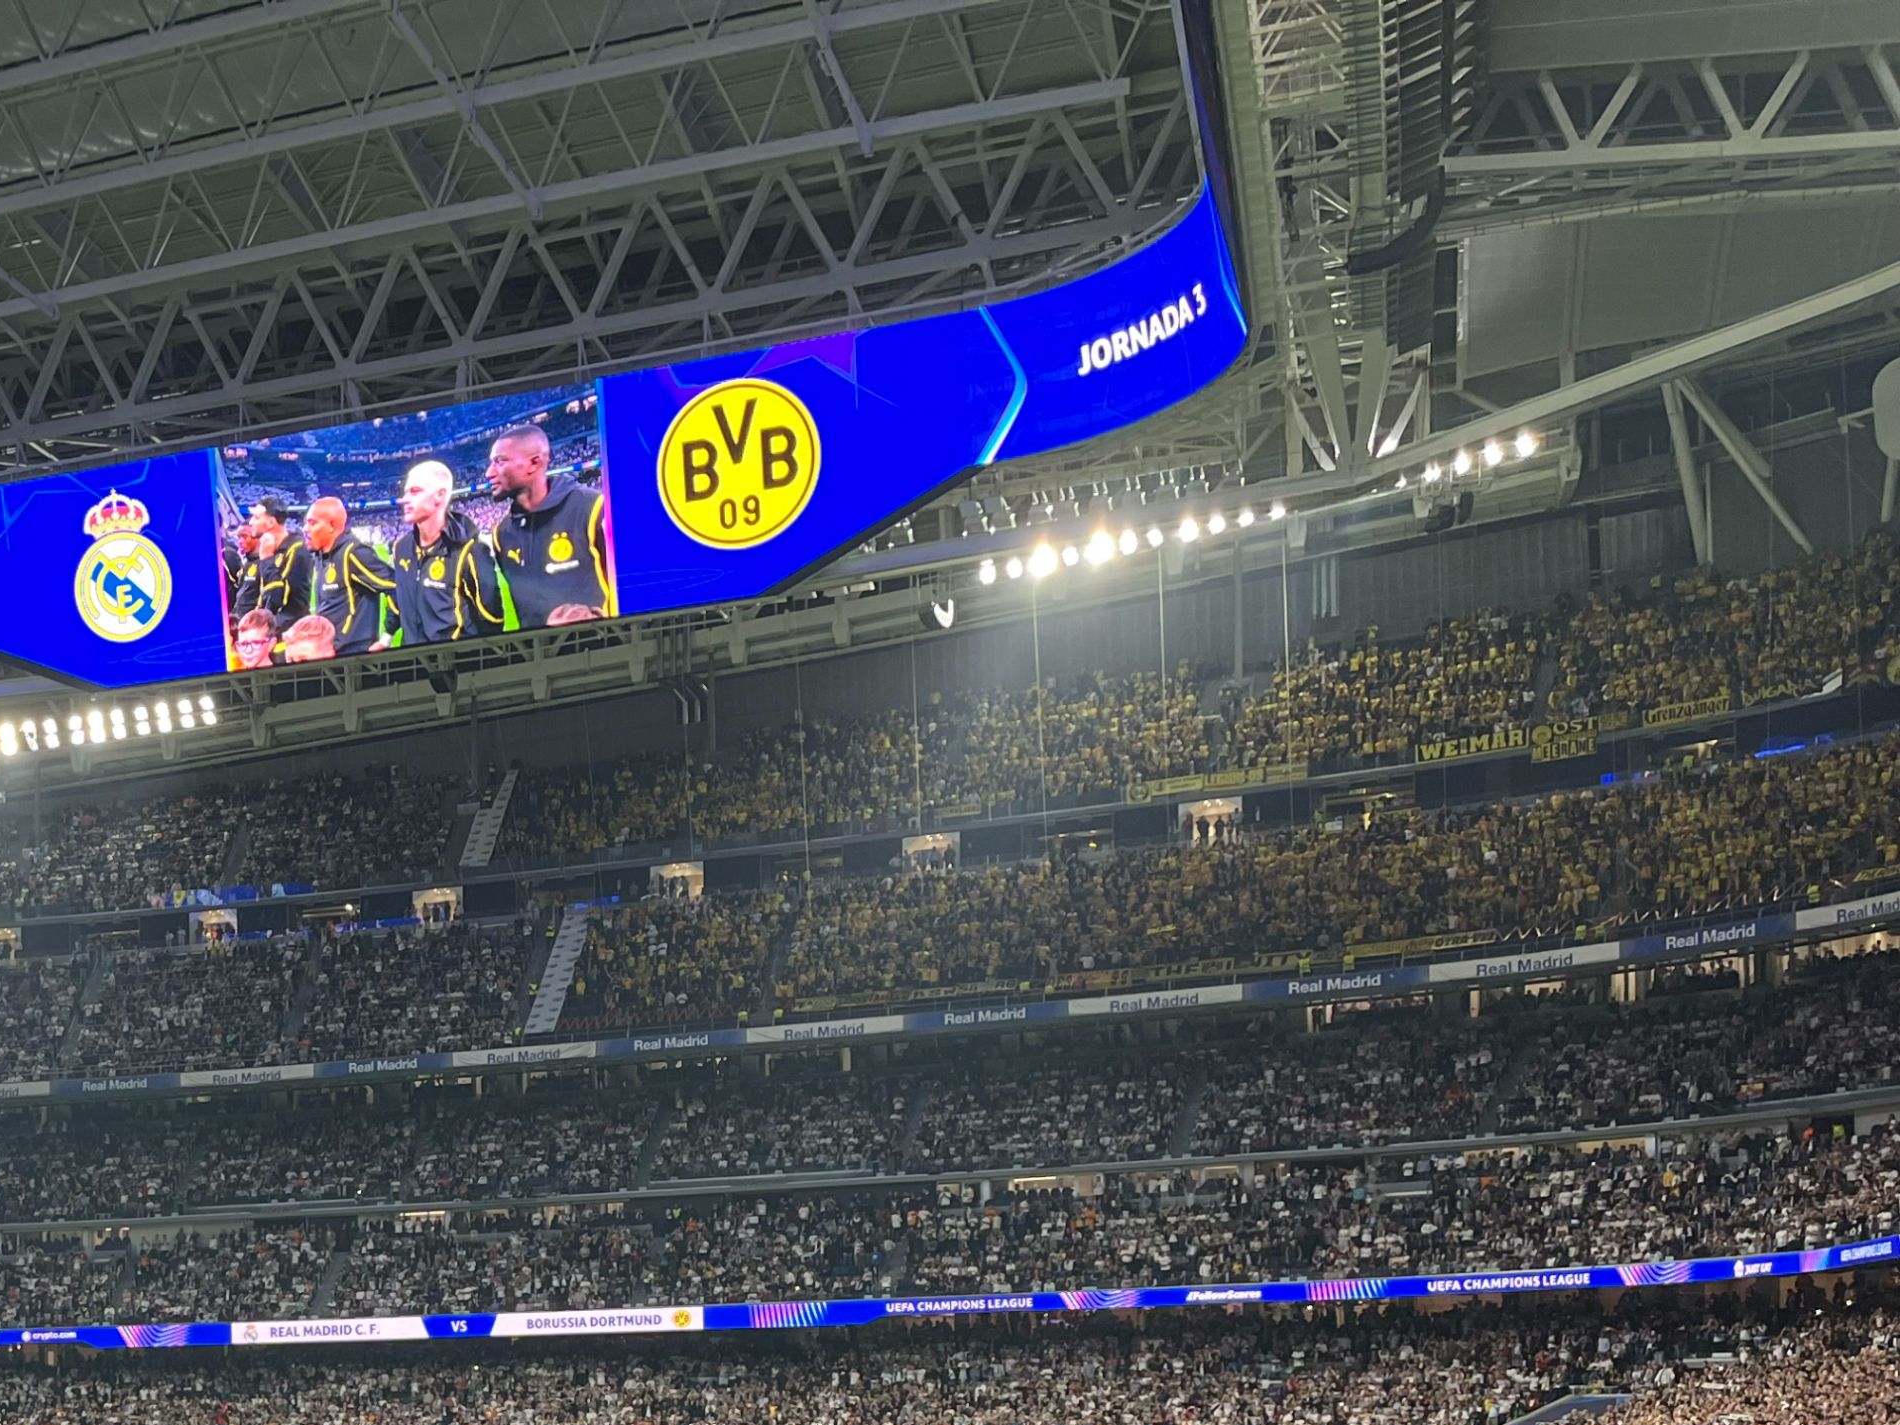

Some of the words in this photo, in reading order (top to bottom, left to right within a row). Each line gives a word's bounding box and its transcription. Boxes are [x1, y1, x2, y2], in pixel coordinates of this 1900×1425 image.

[1077, 312, 1194, 377] JORNADA
[1193, 284, 1208, 316] 3
[682, 397, 798, 503] BVB
[718, 494, 762, 531] 09
[1553, 717, 1598, 735] OST
[1419, 729, 1524, 760] WEIMAR
[1837, 907, 1868, 922] Real
[1871, 897, 1900, 916] Mad
[1665, 934, 1699, 950] Real
[1703, 923, 1756, 942] Madrid
[1476, 963, 1512, 976] Real
[1517, 954, 1573, 972] Madrid
[1288, 980, 1322, 994] Real
[1327, 974, 1382, 990] Madrid
[1110, 999, 1142, 1011] Real
[1148, 993, 1199, 1009] Madrid
[944, 1013, 974, 1025] Real
[977, 1007, 1026, 1022] Madrid
[784, 1028, 813, 1040] Real
[818, 1023, 864, 1038] Madrid
[634, 1039, 661, 1051] Real
[665, 1035, 708, 1048] Madrid
[487, 1053, 513, 1064] Real
[515, 1048, 560, 1061] Madrid
[348, 1062, 374, 1073] Real
[377, 1058, 418, 1071] Madrid
[82, 1081, 106, 1091] Real
[110, 1078, 147, 1090] Madrid
[212, 1074, 238, 1084] Real
[241, 1071, 281, 1082] Madrid
[1427, 1280, 1461, 1291] UEFA
[1463, 1276, 1540, 1290] CHAMPIONS
[1542, 1273, 1590, 1286] LEAGUE
[886, 1302, 915, 1312] UEFA
[917, 1300, 986, 1311] CHAMPIONS
[987, 1298, 1033, 1309] LEAGUE
[270, 1327, 300, 1337] REAL
[303, 1325, 352, 1337] MADRID
[355, 1324, 367, 1335] C.
[370, 1324, 381, 1335] F.
[451, 1320, 468, 1332] VS
[527, 1317, 587, 1329] BORUSSIA
[590, 1314, 662, 1326] DORTMUND
